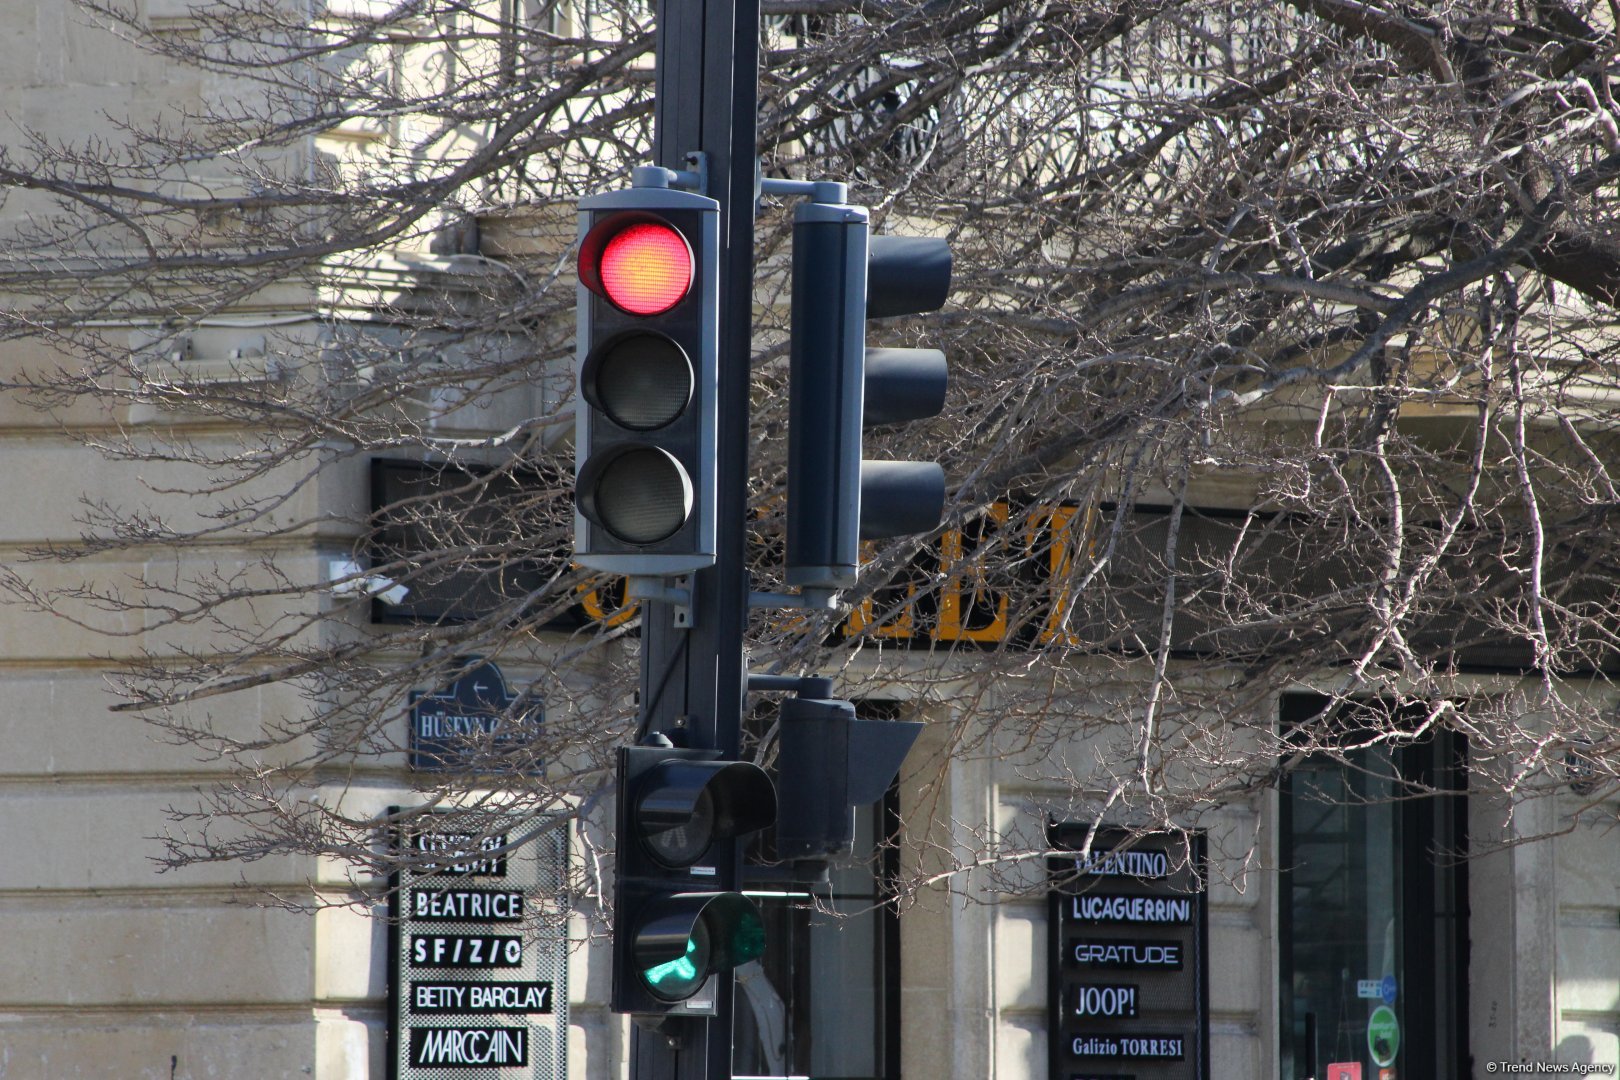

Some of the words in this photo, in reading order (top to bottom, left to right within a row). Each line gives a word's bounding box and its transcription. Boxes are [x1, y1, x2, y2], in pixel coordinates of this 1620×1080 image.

[416, 892, 520, 917] BEATRICE
[1074, 944, 1179, 964] GRATUDE
[416, 986, 466, 1008] BETTY
[470, 986, 547, 1008] BARCLAY
[1075, 987, 1135, 1016] JOOP!
[1072, 1037, 1118, 1056] Galizio
[1120, 1038, 1183, 1056] TORRESI
